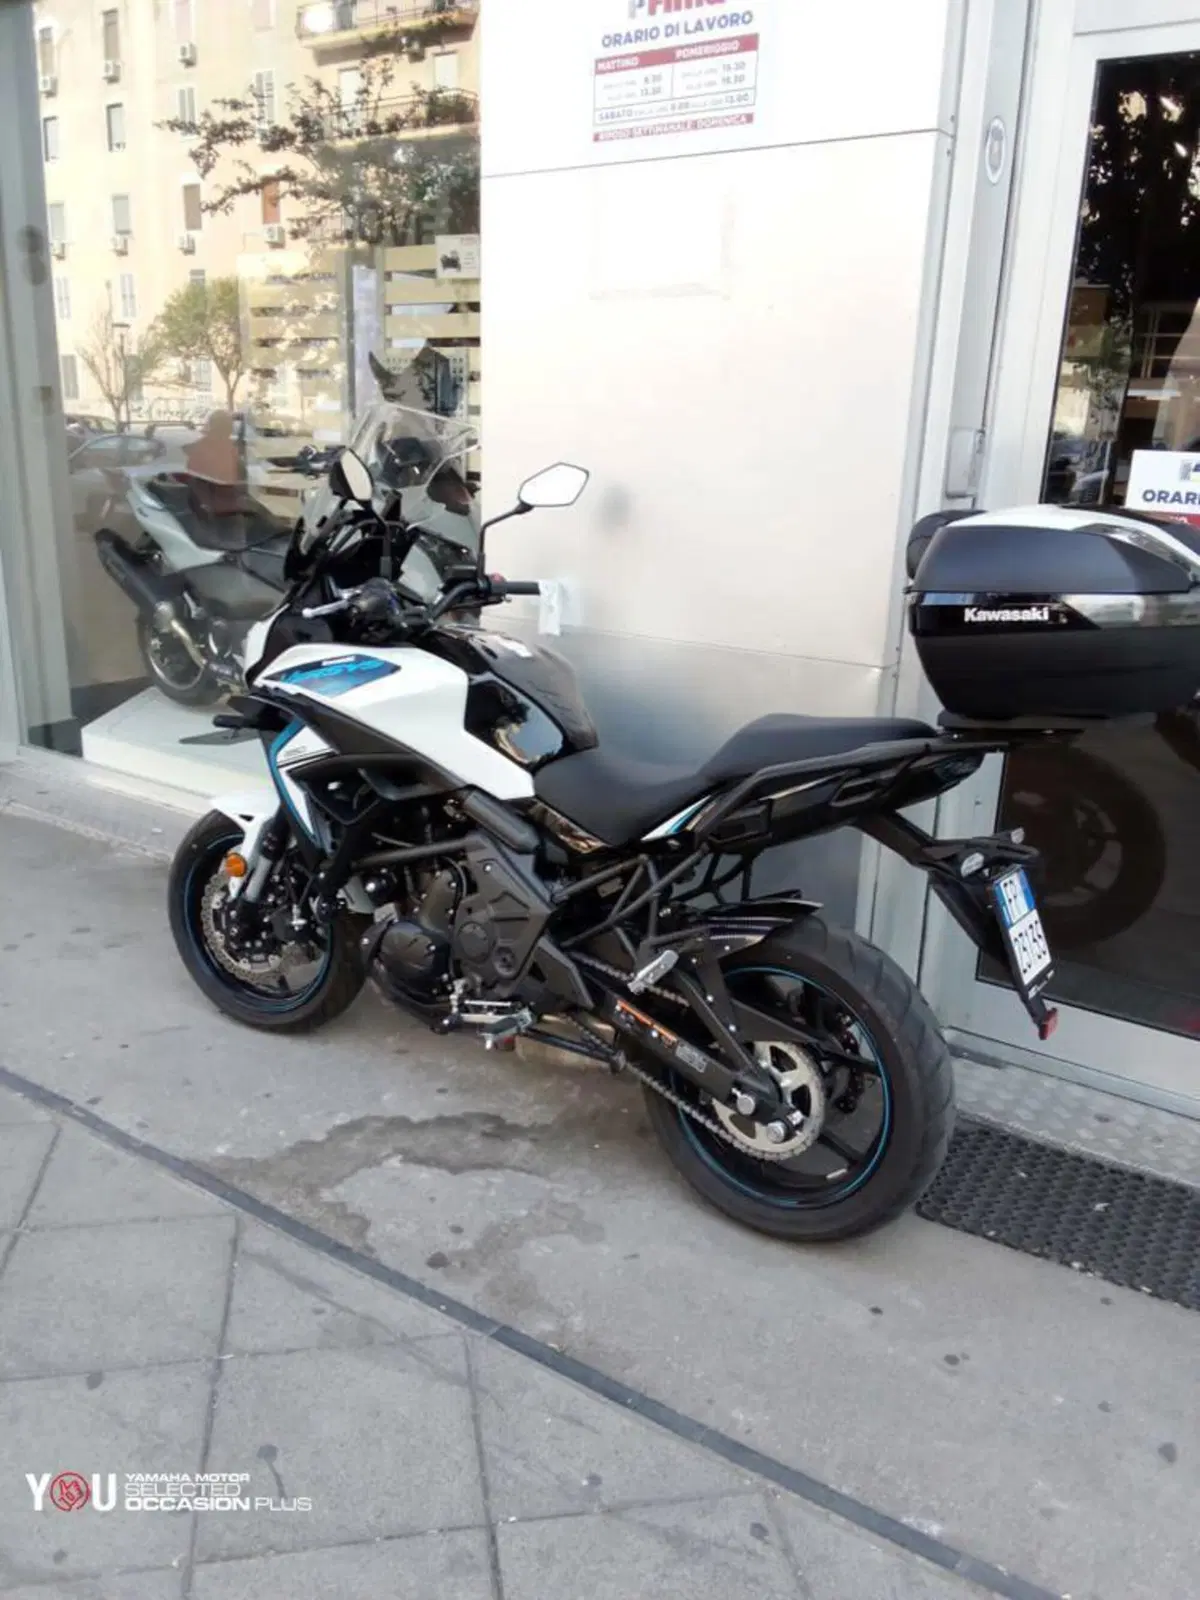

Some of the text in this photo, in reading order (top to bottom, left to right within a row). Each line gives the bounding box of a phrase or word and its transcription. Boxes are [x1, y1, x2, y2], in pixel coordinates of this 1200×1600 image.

[601, 10, 754, 48] ORARIO DI LAVORO
[964, 606, 1049, 622] Kawasaki
